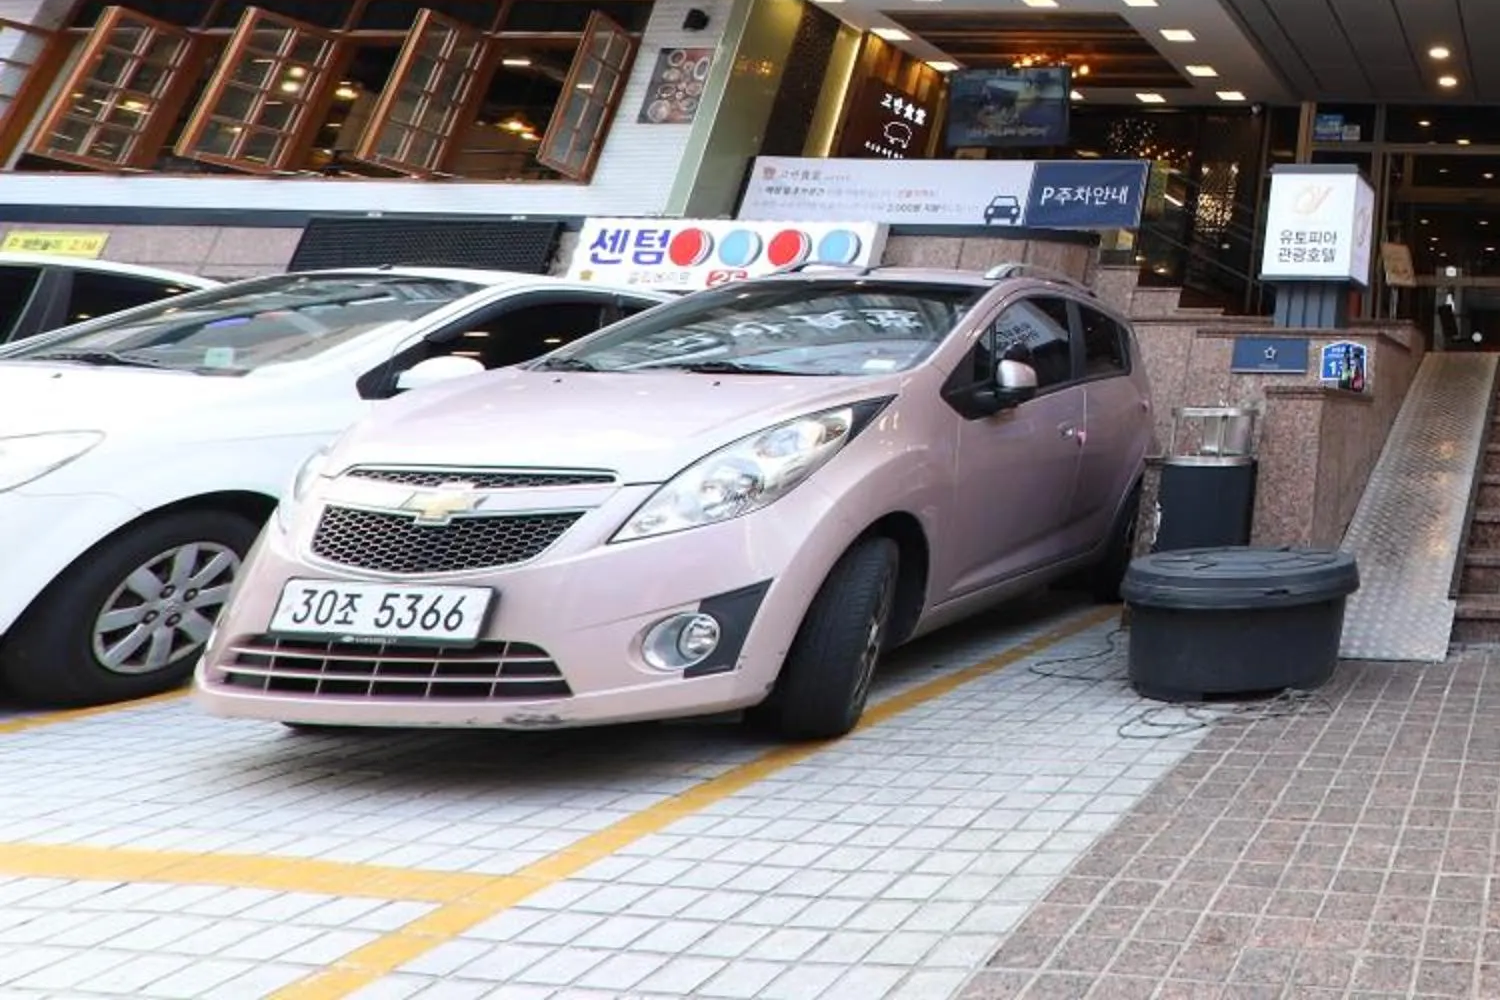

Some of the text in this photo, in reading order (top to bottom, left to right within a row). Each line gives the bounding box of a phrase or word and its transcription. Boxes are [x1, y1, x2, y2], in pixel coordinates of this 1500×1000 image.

[589, 228, 671, 265] 센텀
[1280, 229, 1338, 245] 유토피아
[1278, 247, 1337, 263] 관광호텔
[292, 589, 467, 632] 30조 5366
